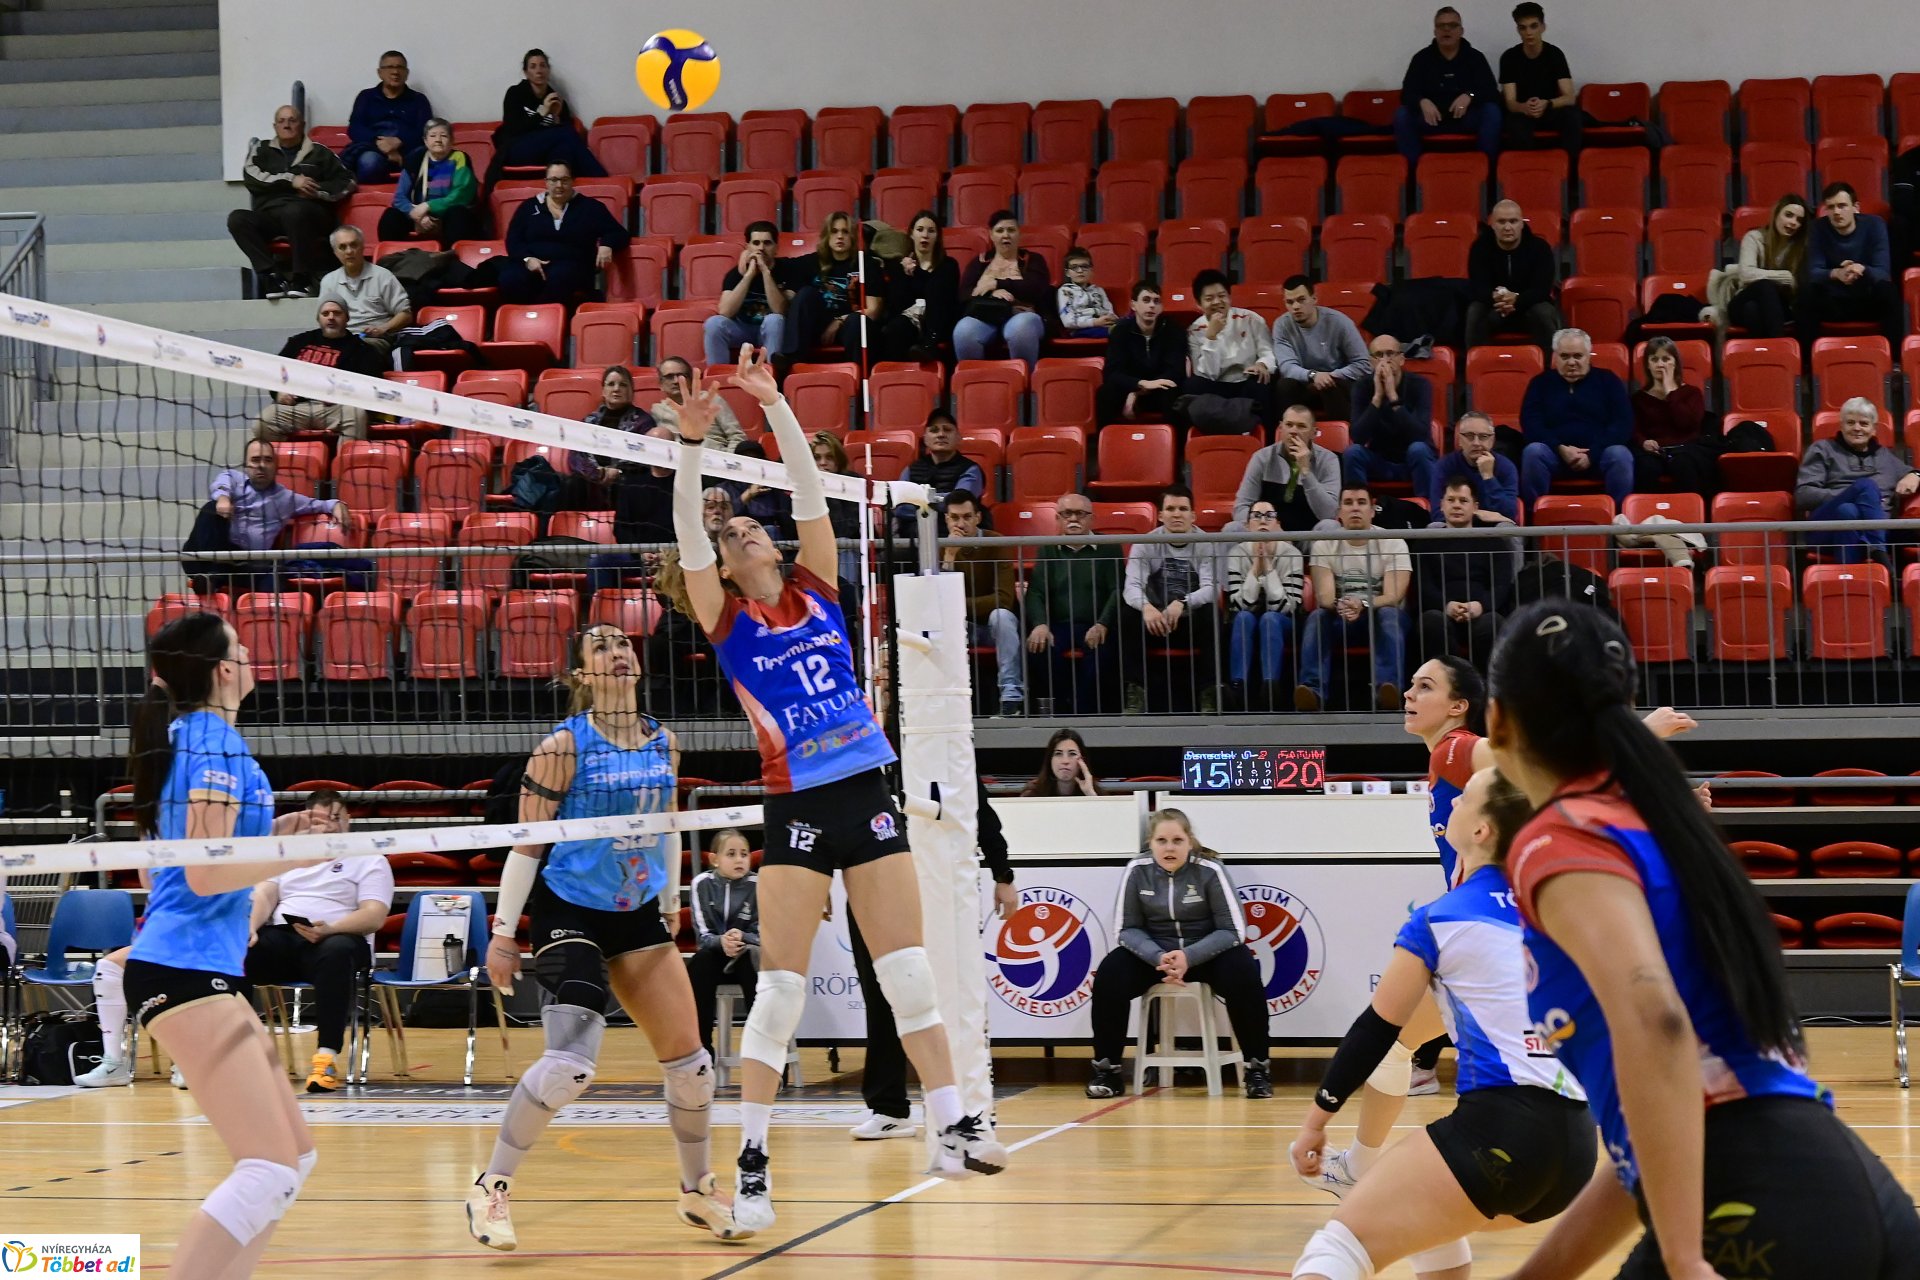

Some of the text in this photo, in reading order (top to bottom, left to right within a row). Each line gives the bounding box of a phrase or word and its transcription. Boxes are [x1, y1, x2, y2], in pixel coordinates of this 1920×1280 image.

[790, 654, 836, 696] 12
[782, 688, 865, 730] FATUM
[1277, 750, 1325, 760] FATUM
[1188, 762, 1231, 788] 15
[1277, 761, 1323, 788] 20
[789, 828, 817, 852] 12
[1022, 889, 1075, 909] ATUM
[1239, 888, 1290, 907] ATUM
